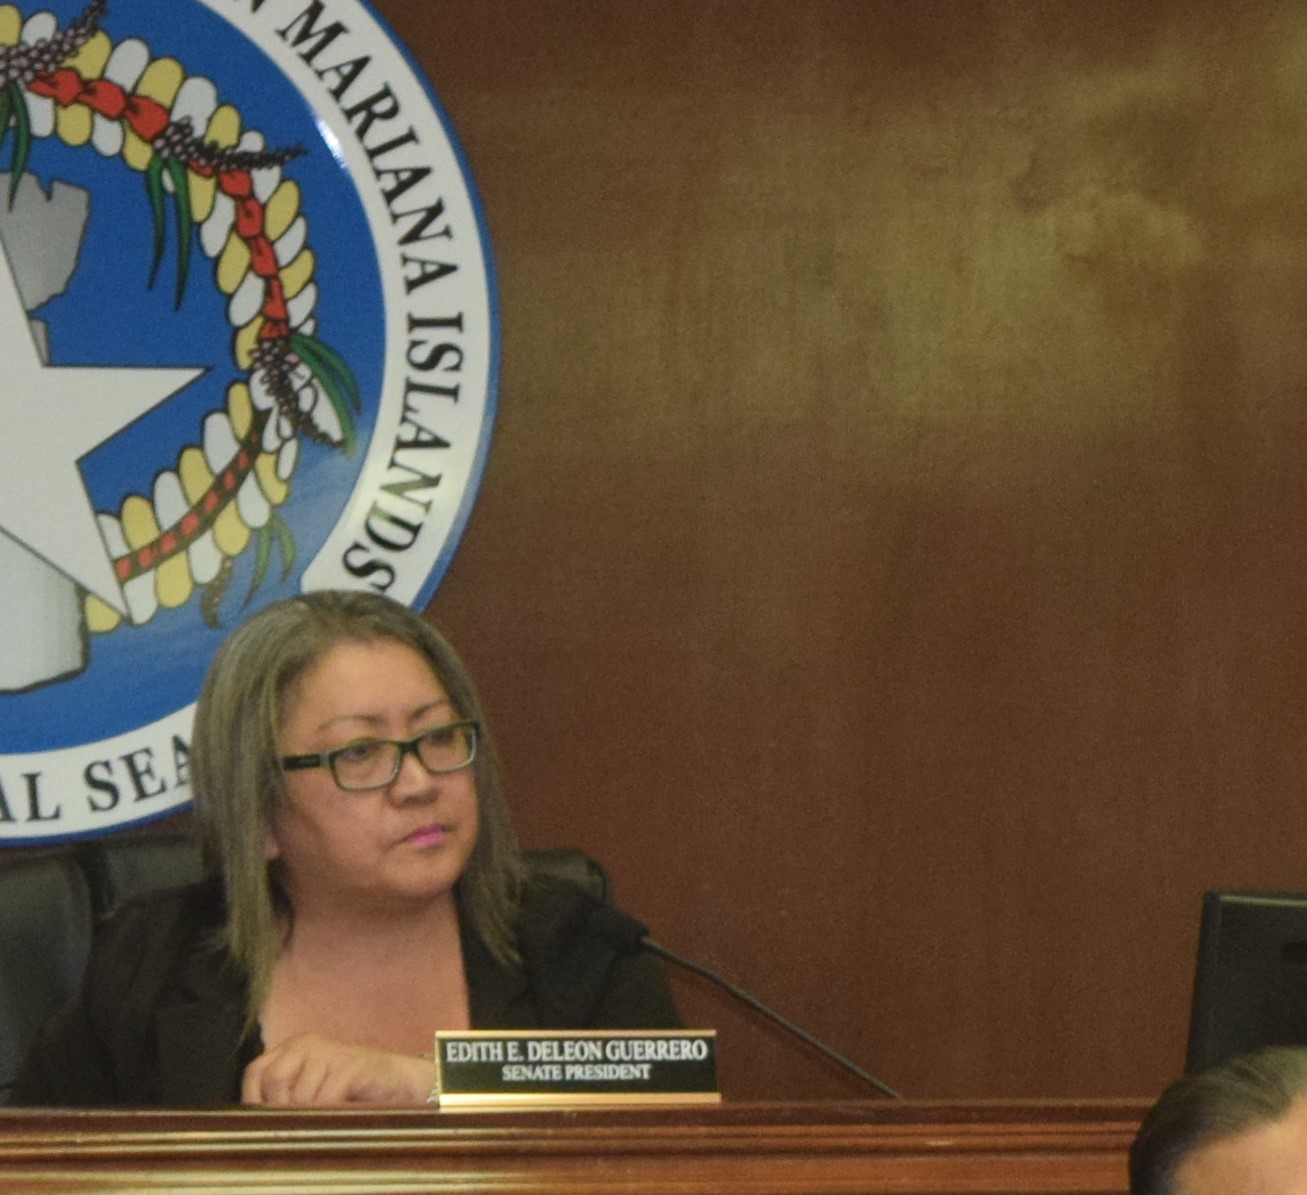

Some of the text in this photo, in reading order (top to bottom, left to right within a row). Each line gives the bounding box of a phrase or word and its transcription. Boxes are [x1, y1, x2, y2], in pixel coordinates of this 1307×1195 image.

[275, 0, 464, 593] MARIANA ISLANDS
[446, 1039, 708, 1063] EDITH E. DELEON GUERRERO
[502, 1064, 651, 1081] SENATE PRESIDENT
